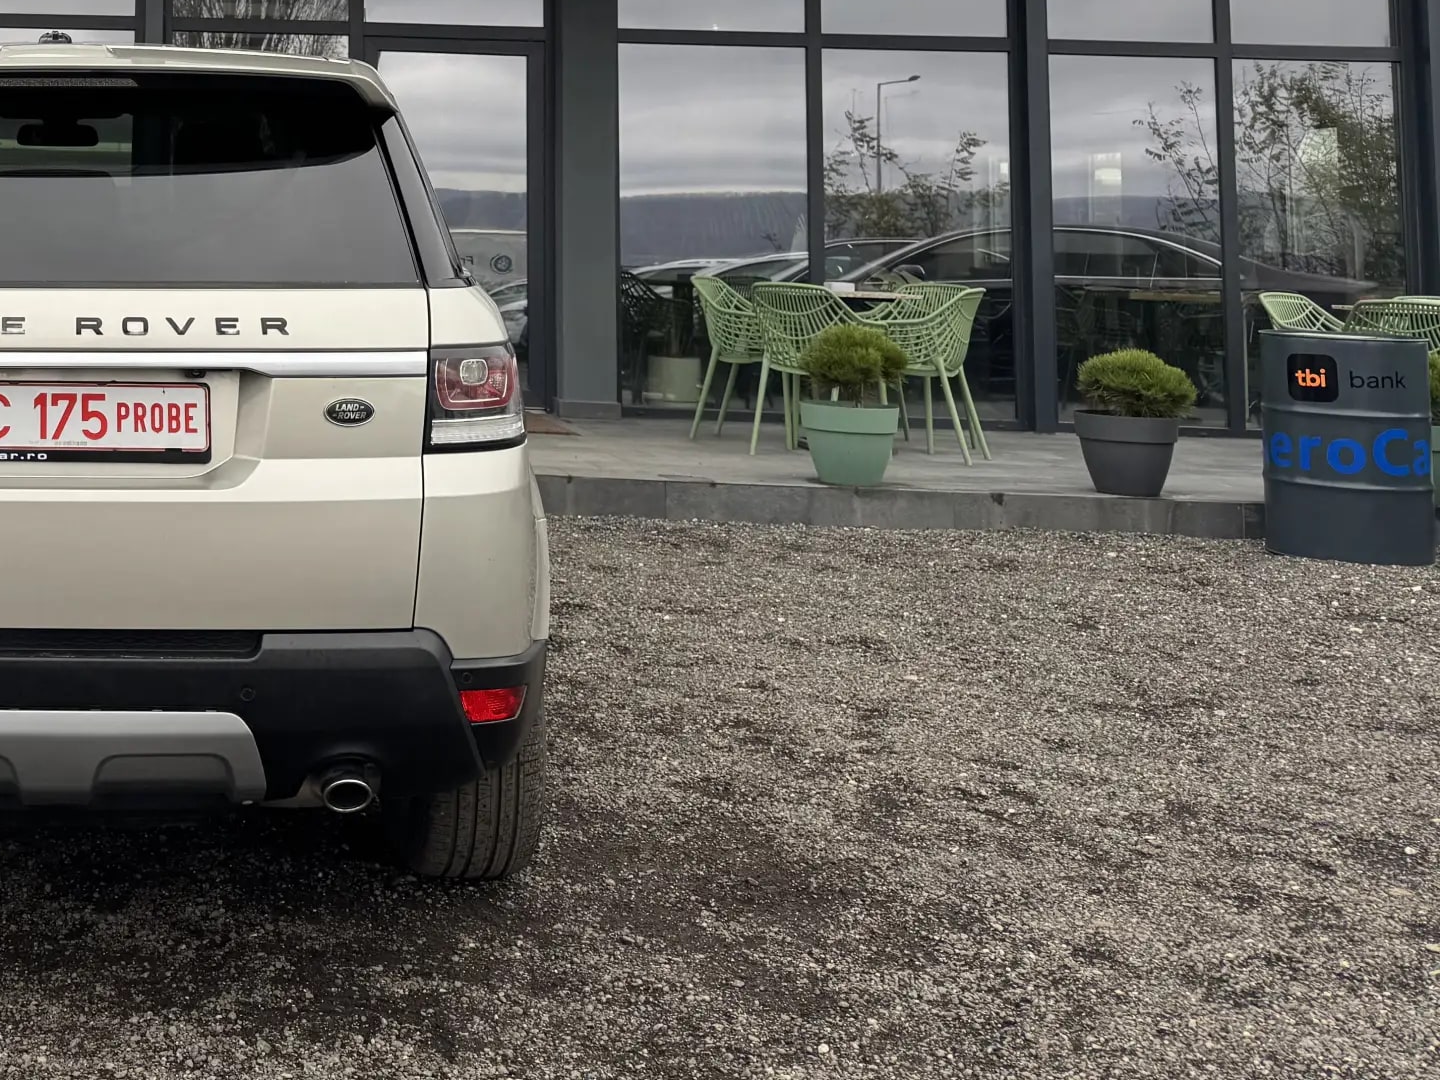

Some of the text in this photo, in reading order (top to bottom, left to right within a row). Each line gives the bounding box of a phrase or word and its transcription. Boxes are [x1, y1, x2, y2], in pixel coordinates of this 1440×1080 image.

[76, 317, 290, 336] ROVER
[1295, 368, 1406, 390] tbi bank
[33, 392, 108, 441] 175
[116, 402, 198, 434] PROBE
[1264, 428, 1431, 477] eroCa
